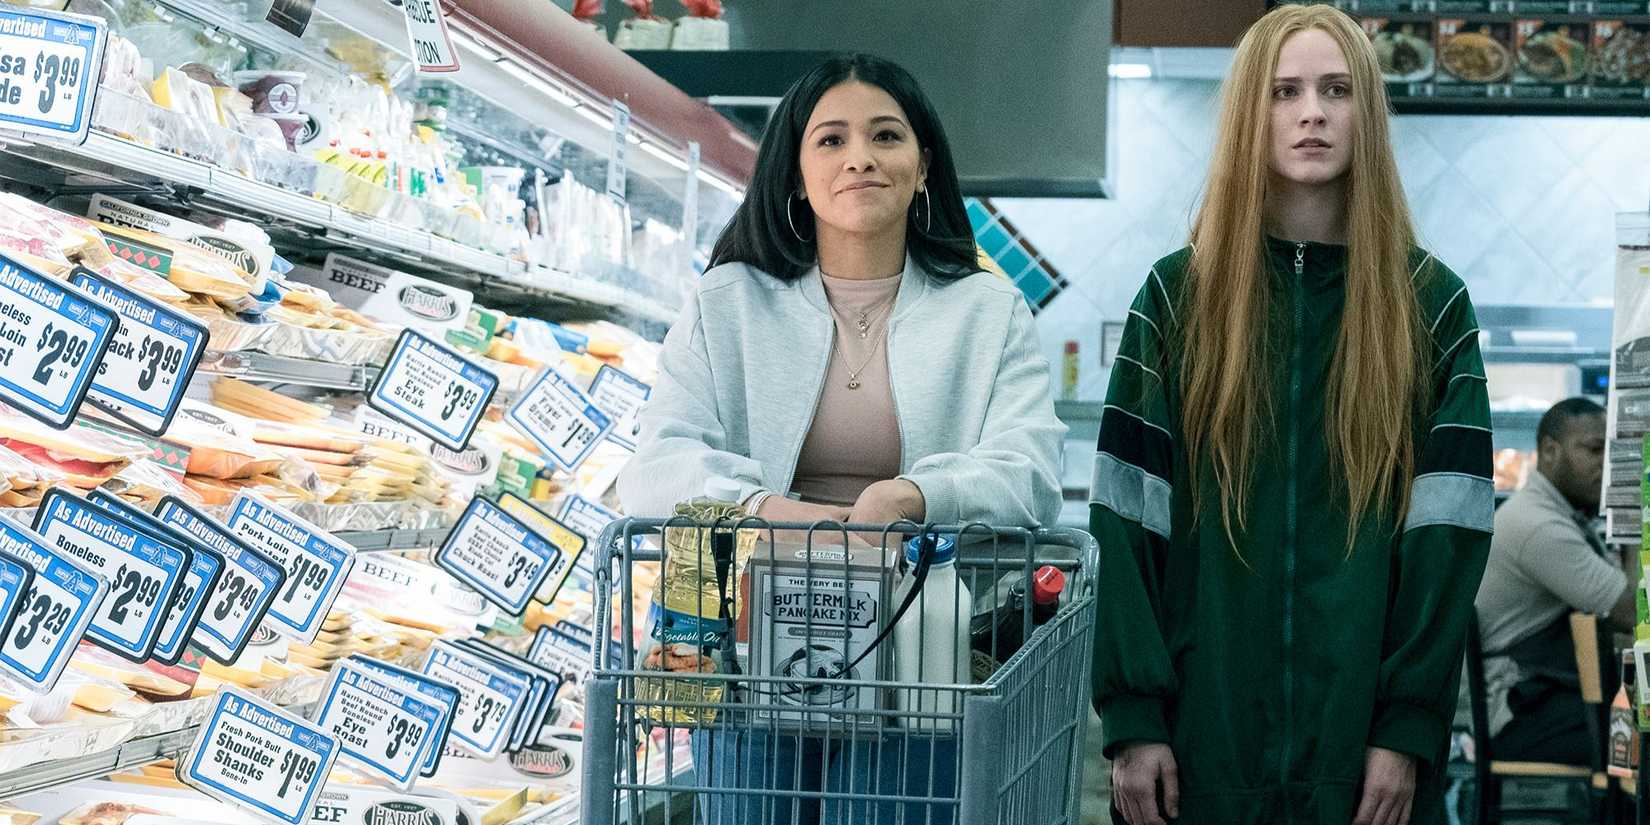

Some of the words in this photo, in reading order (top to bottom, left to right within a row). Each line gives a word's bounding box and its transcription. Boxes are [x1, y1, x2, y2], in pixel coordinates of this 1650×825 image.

[34, 51, 80, 113] $399
[1, 265, 65, 310] Advertised
[328, 268, 387, 295] BEEF
[80, 279, 96, 296] As
[97, 286, 156, 325] Advertised
[32, 322, 88, 386] $299
[138, 334, 182, 391] $399
[394, 386, 425, 409] Steak
[404, 380, 425, 398] Eye
[440, 380, 477, 420] $399
[54, 501, 72, 521] As
[72, 510, 138, 551] Advertised
[172, 507, 187, 525] As
[188, 518, 244, 561] Advertised
[241, 522, 265, 542] Pork
[266, 536, 290, 556] Loin
[242, 499, 256, 518] As
[258, 509, 310, 547] Advertised
[56, 534, 106, 568] Boneless
[108, 562, 161, 625] $299
[214, 569, 258, 621] $349
[282, 553, 328, 603] $199
[788, 578, 805, 587] THE
[14, 586, 71, 650] $329
[773, 592, 868, 612] BUTERMLK
[655, 626, 700, 642] Vgetabl
[224, 695, 240, 713] As
[240, 703, 296, 740] Advertised
[342, 717, 367, 736] Eye
[473, 694, 507, 733] $379
[216, 733, 275, 768] Shoulder
[221, 720, 243, 737] Fresh
[245, 731, 262, 746] Pork
[264, 742, 281, 755] Butt
[332, 725, 369, 749] Roast
[386, 713, 423, 760] $399
[214, 749, 264, 781] Shanks
[220, 767, 248, 785] Bone-In
[276, 749, 317, 799] $199
